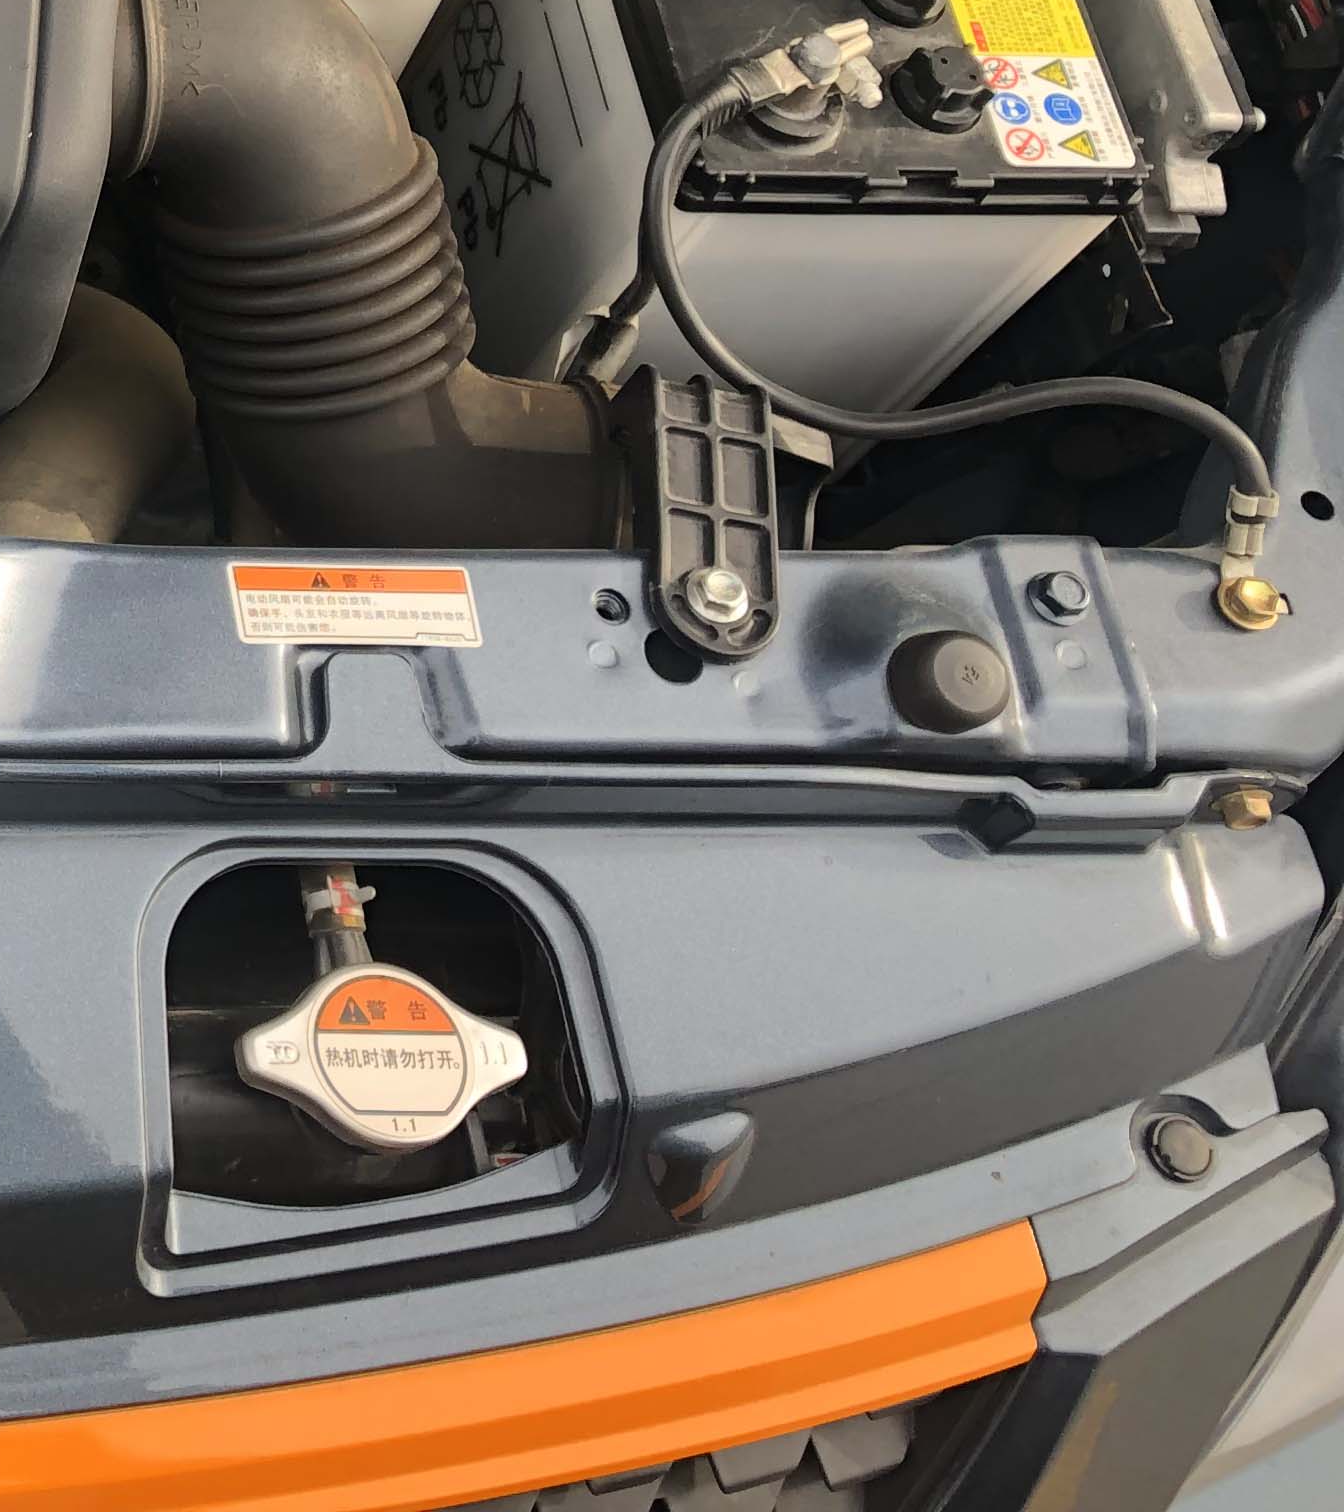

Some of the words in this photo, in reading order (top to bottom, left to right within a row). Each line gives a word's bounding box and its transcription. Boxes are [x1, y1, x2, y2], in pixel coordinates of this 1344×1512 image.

[341, 573, 386, 589] 警告
[366, 999, 428, 1021] 警告
[391, 1117, 417, 1133] 1.1
